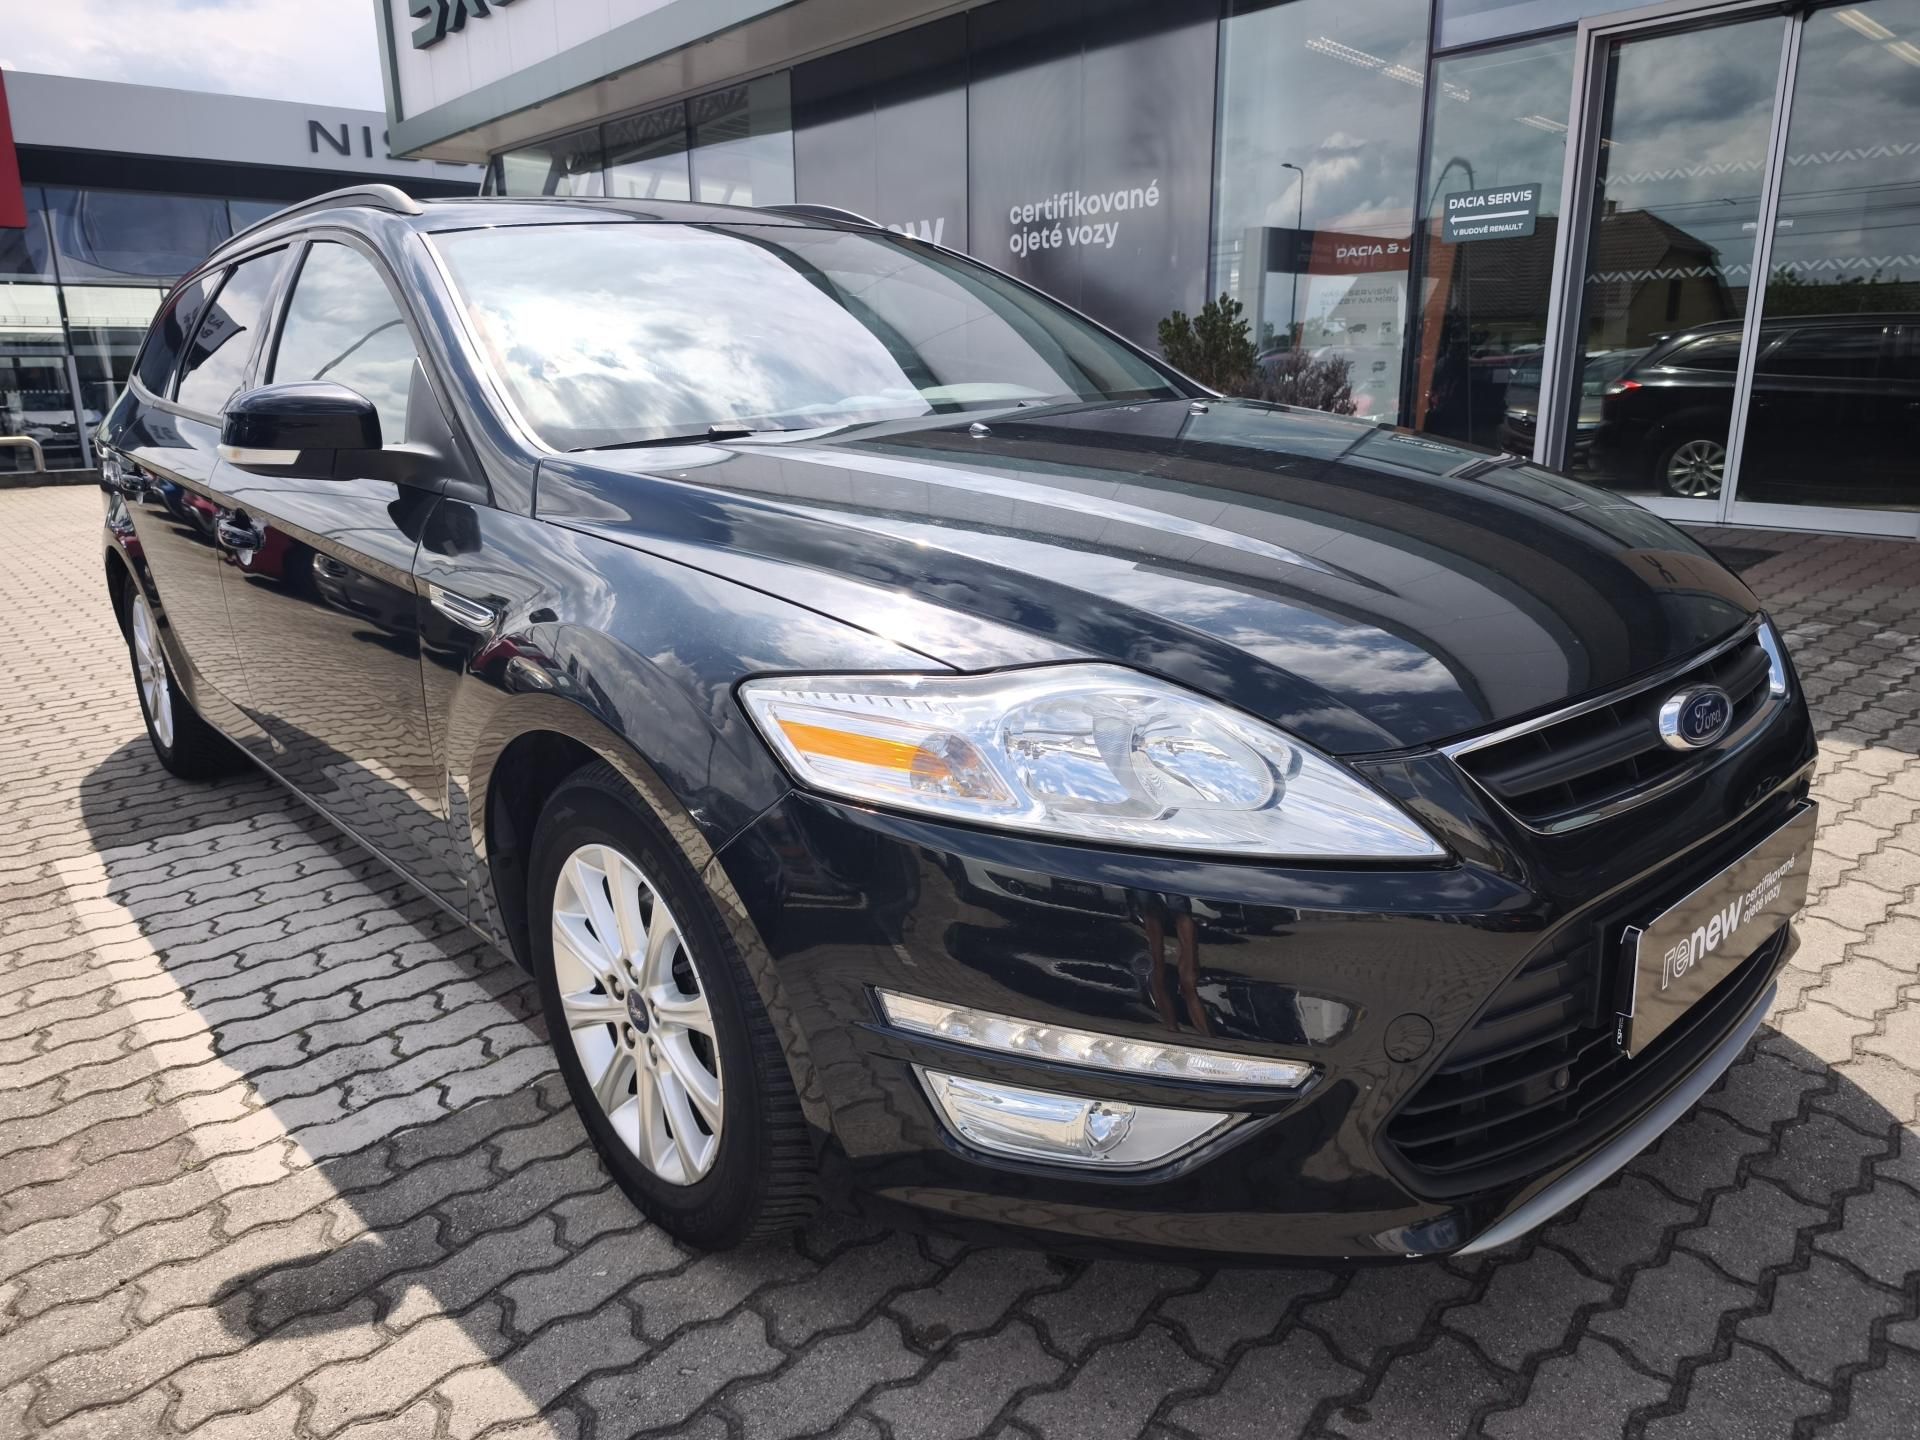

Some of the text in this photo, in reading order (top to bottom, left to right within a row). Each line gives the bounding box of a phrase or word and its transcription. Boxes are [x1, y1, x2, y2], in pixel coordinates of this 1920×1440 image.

[1010, 178, 1160, 225] certifikované
[1449, 190, 1533, 210] DACIA SERVIS
[1009, 221, 1119, 258] ojeté vozy
[1489, 222, 1524, 233] RENAULT
[1336, 244, 1383, 259] DACIA
[1387, 242, 1399, 254] &
[1695, 700, 1721, 734] Ford
[1745, 852, 1795, 905] certifikované
[1743, 882, 1782, 924] ojeté vozy
[1662, 895, 1743, 990] renew
